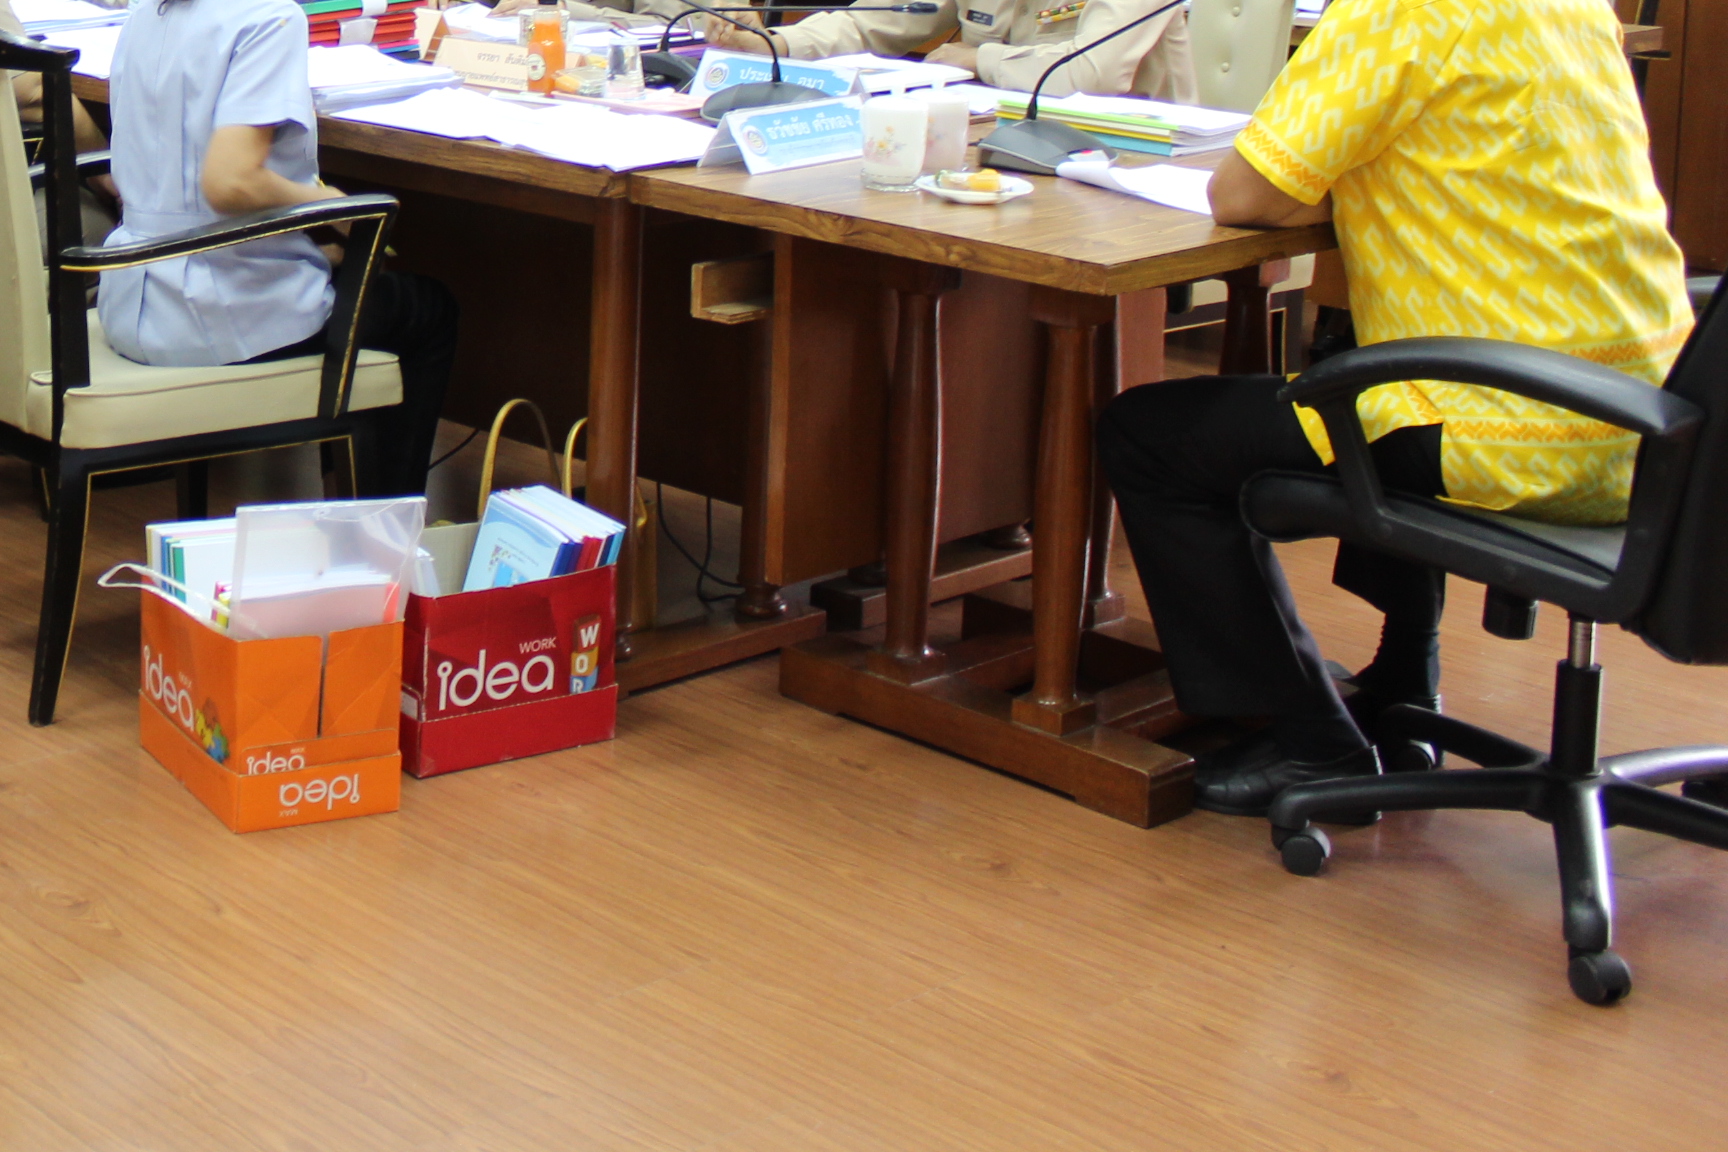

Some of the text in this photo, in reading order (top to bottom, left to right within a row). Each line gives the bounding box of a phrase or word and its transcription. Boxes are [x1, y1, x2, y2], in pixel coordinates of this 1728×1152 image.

[812, 112, 854, 133] ศรีทอง
[518, 636, 557, 655] WORK
[143, 644, 195, 733] idea
[437, 648, 556, 711] idea
[246, 751, 306, 776] idea
[279, 773, 360, 811] idea
